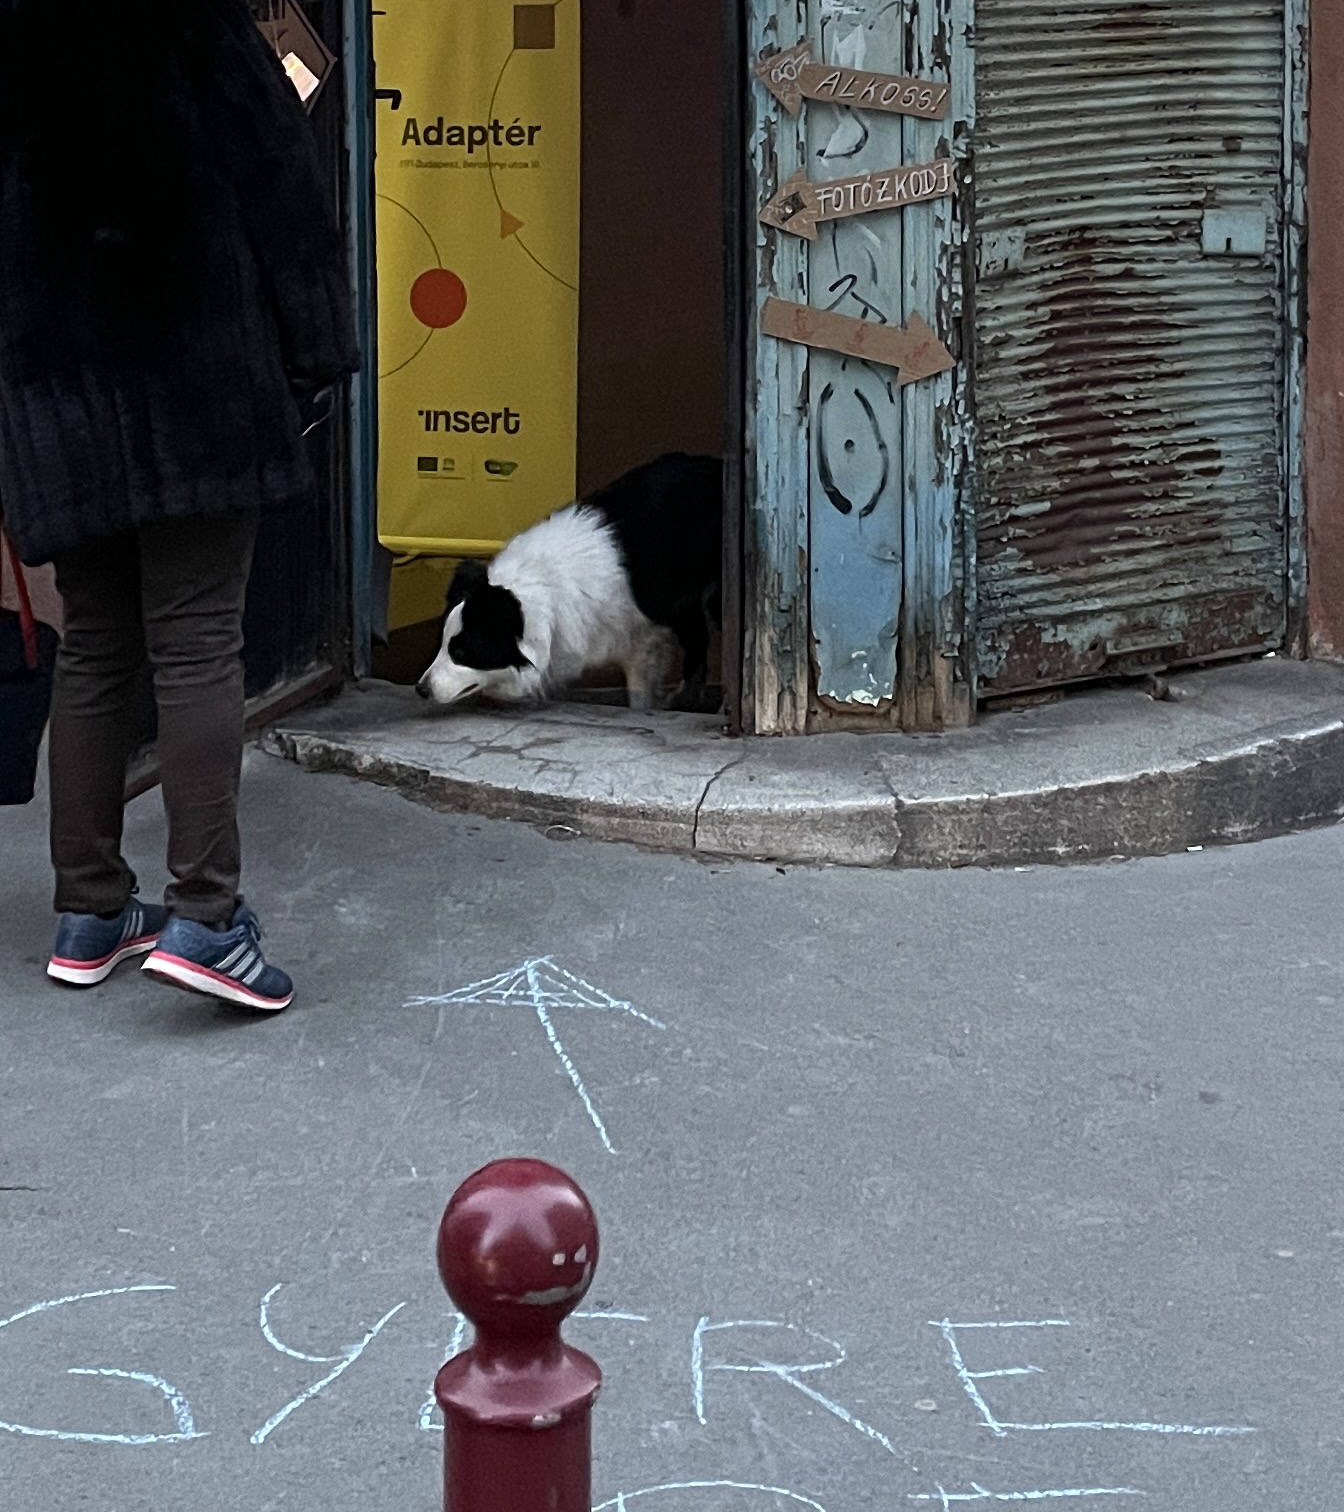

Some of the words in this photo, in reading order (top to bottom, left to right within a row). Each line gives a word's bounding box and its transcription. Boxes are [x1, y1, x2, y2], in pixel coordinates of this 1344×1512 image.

[815, 71, 947, 113] ALKOSS!
[401, 116, 541, 154] Adaptér
[815, 162, 951, 215] FOTÓZKODJ
[418, 407, 520, 434] insert
